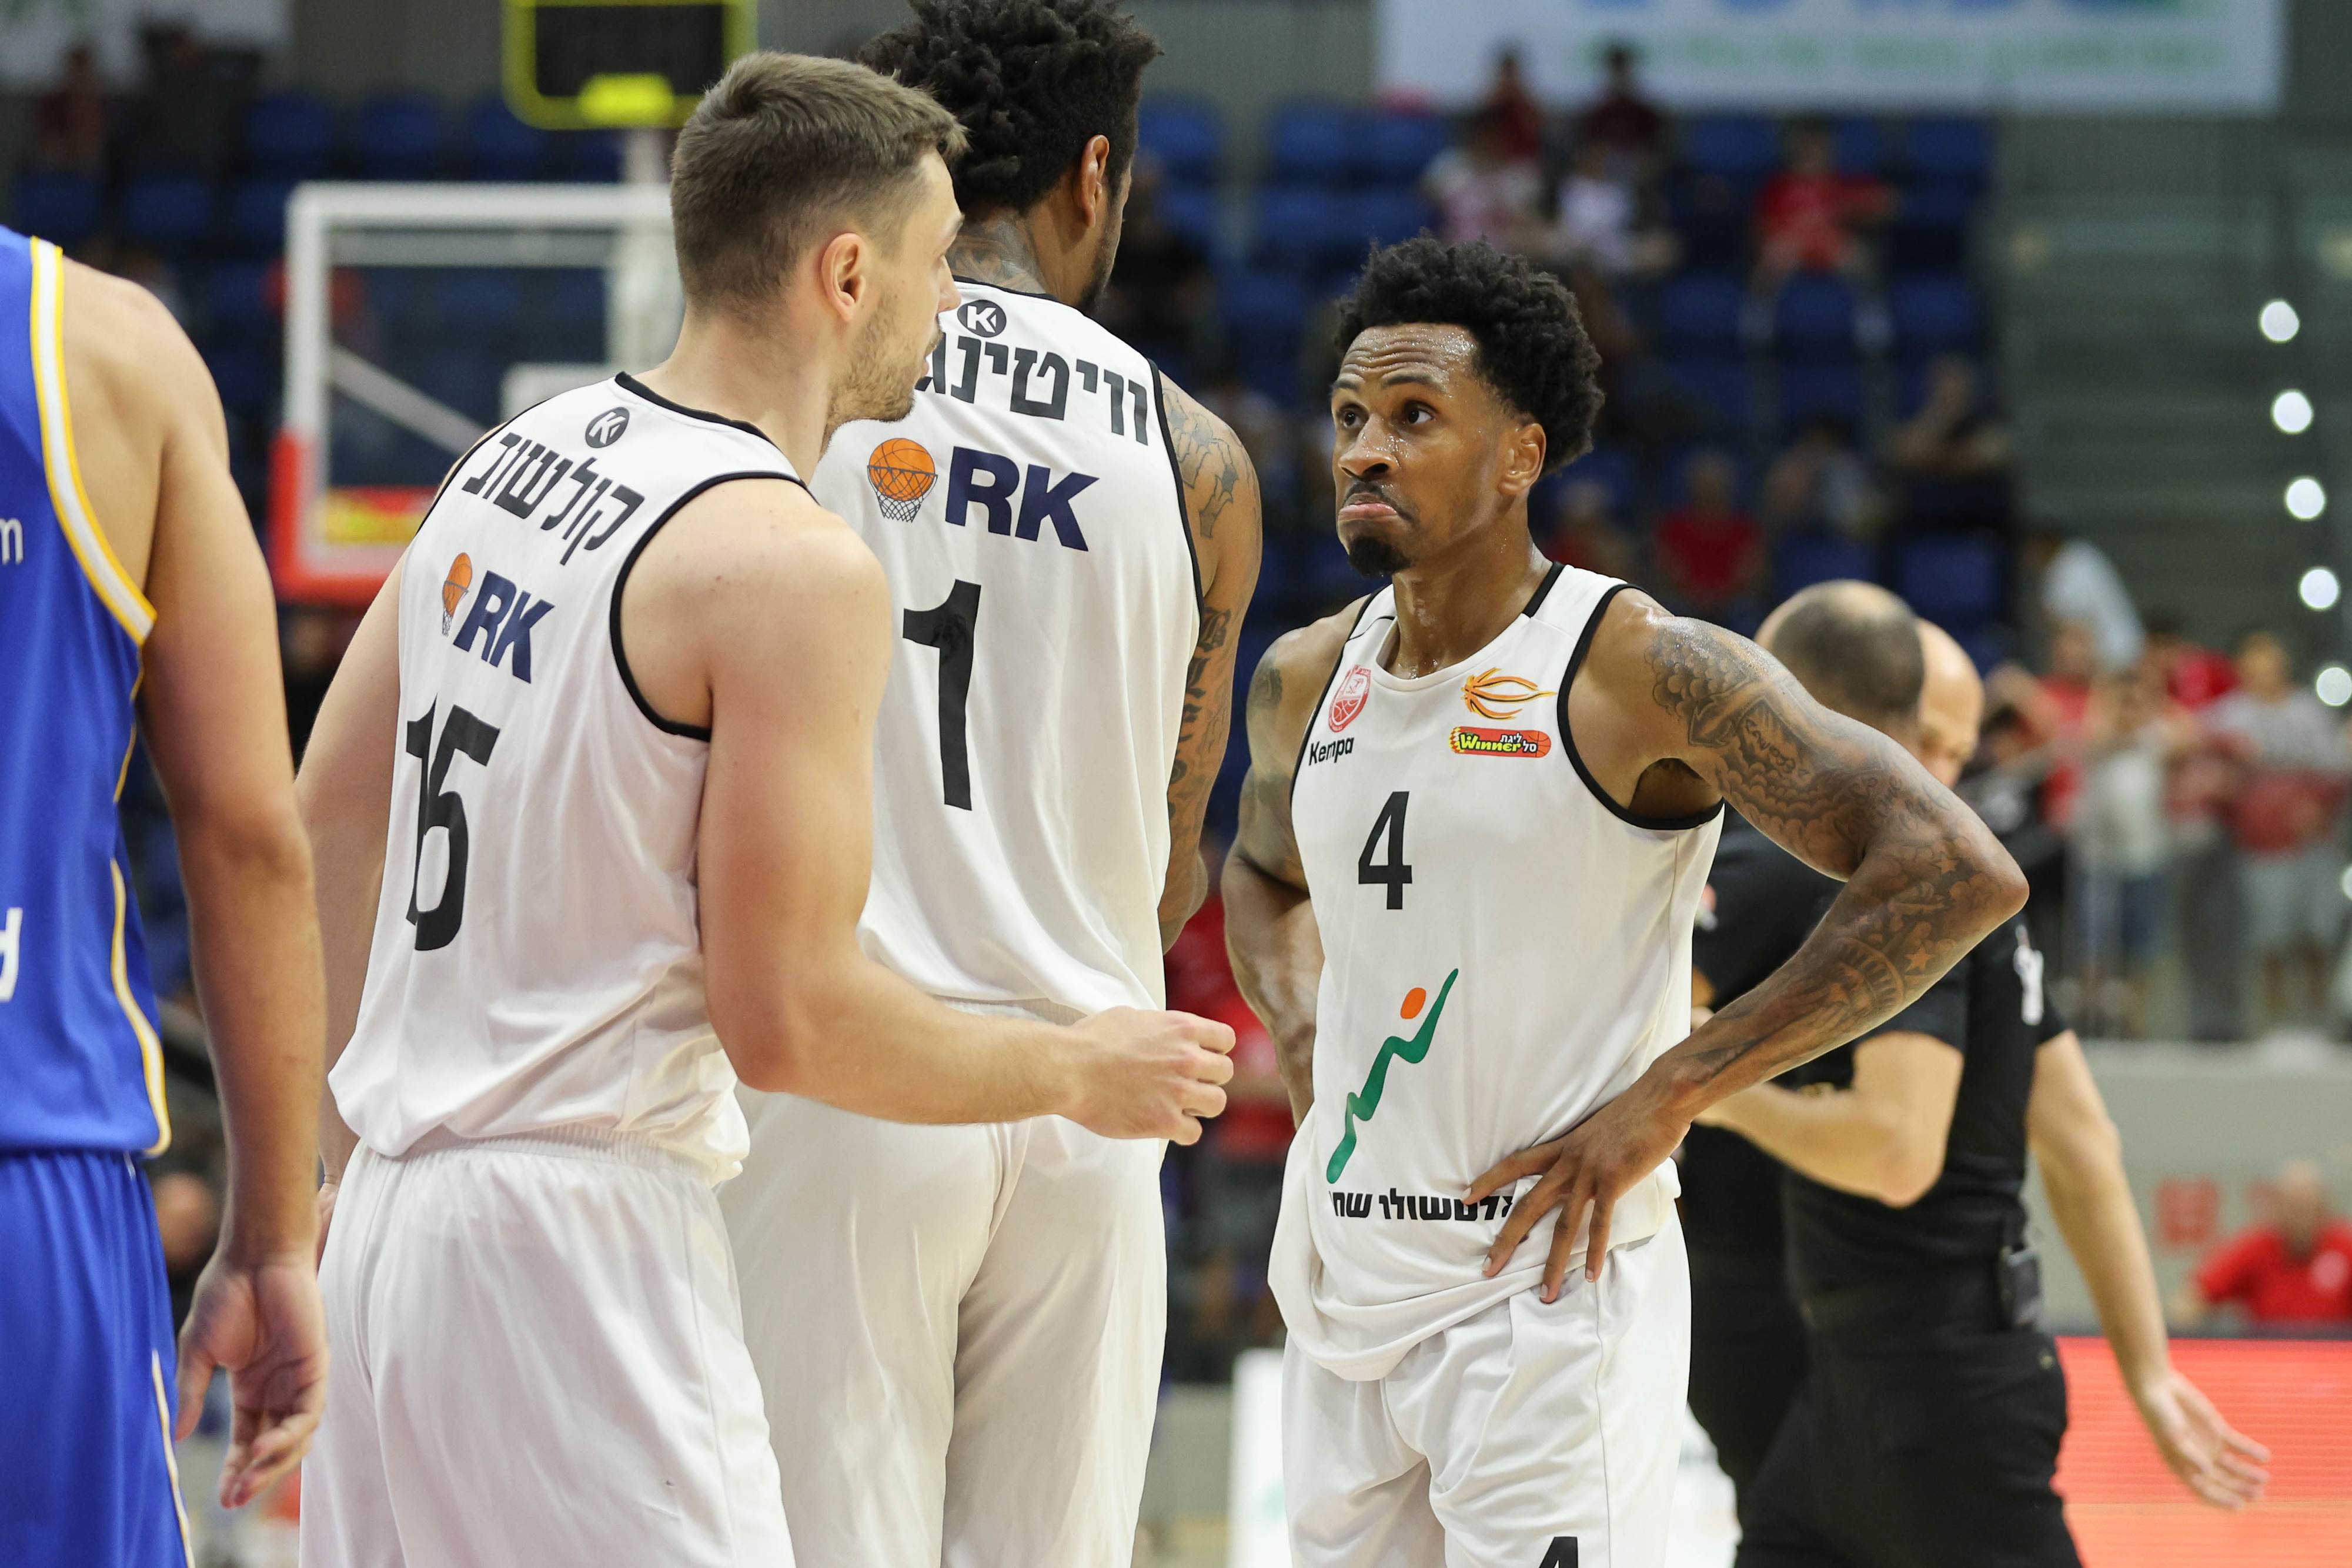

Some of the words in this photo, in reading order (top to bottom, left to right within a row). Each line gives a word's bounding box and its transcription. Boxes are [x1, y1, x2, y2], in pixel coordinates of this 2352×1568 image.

[945, 446, 1100, 552] RK
[453, 570, 554, 684] RK
[903, 579, 981, 811] 1
[1309, 737, 1355, 765] Kempa
[1459, 734, 1522, 753] Winner
[1499, 732, 1523, 743] ליגת
[1522, 740, 1538, 753] סל
[406, 692, 500, 951] 15
[1358, 791, 1412, 910] 4
[1329, 1191, 1373, 1218] שח
